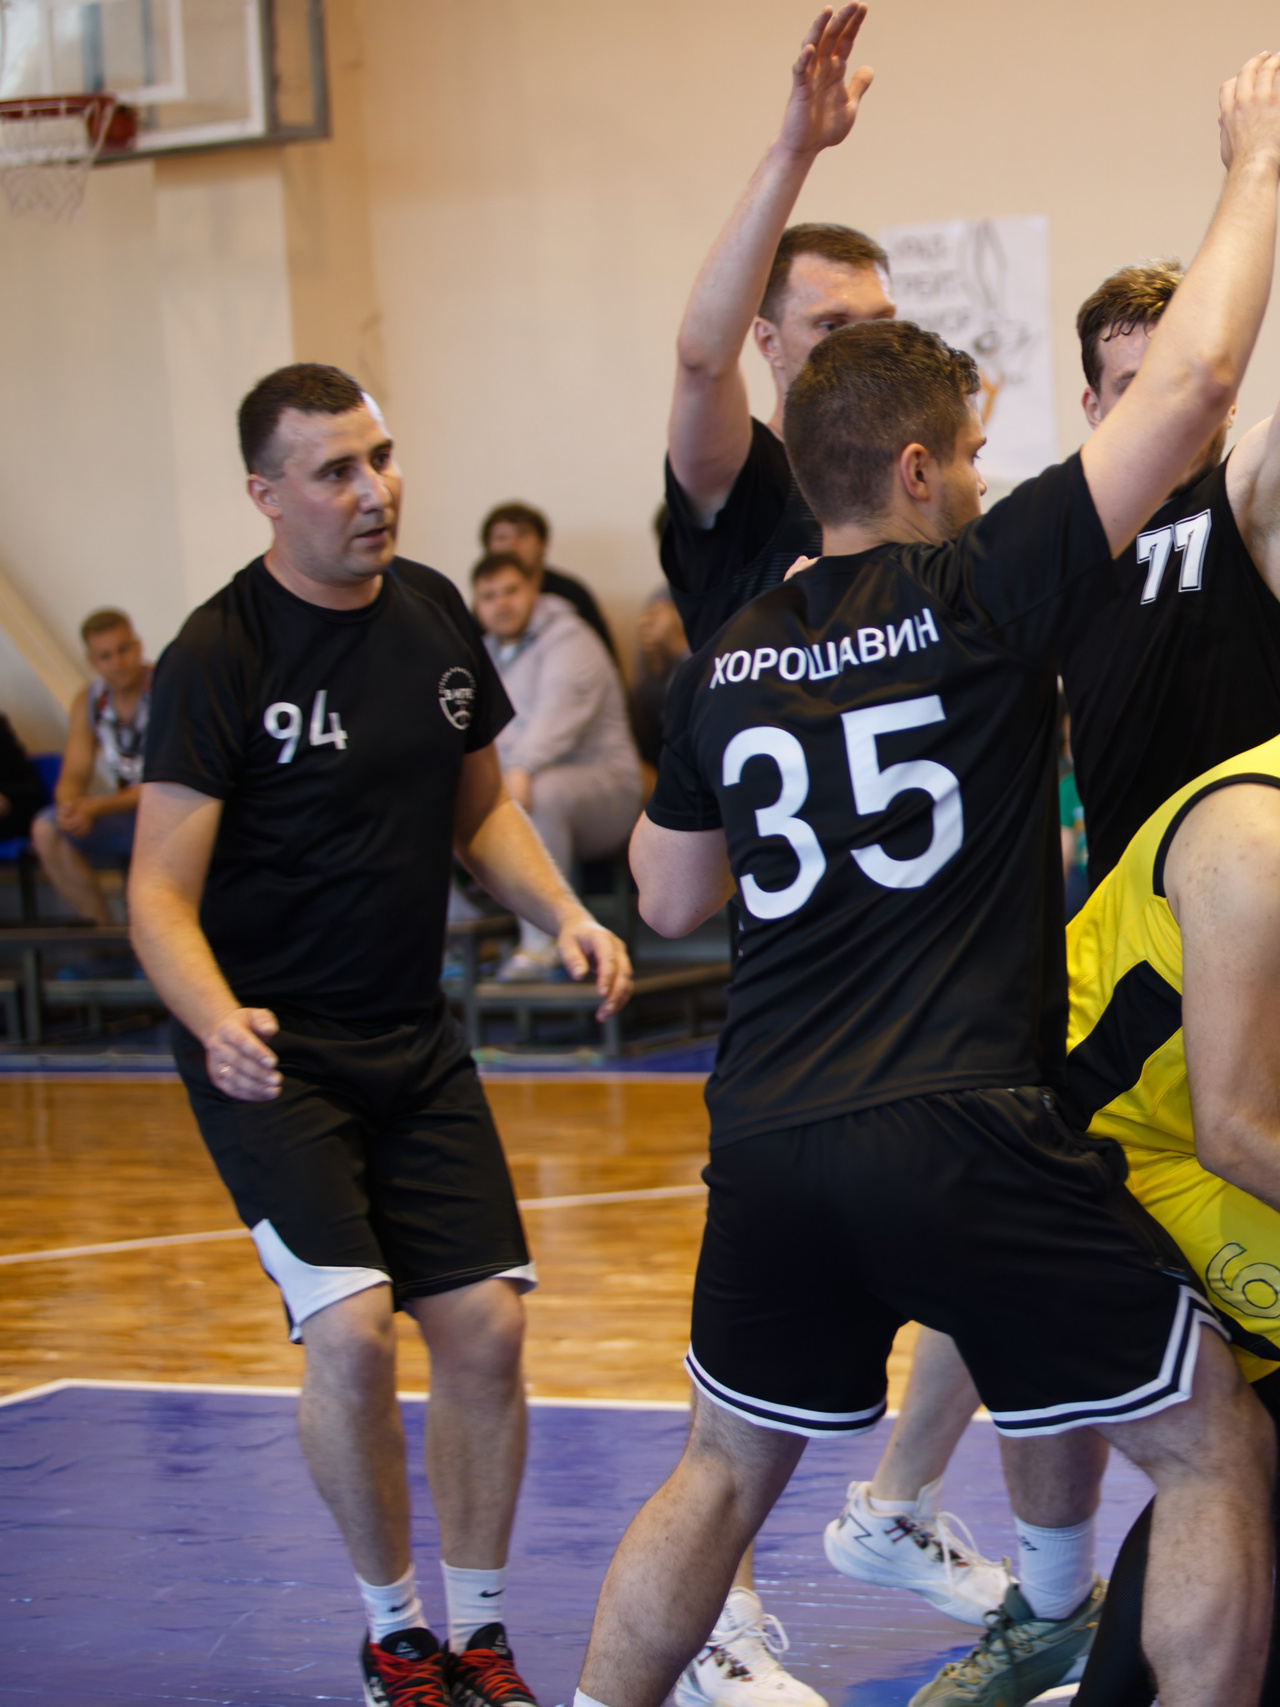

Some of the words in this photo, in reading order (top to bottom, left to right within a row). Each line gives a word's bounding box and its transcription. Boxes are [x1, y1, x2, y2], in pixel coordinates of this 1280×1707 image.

[1136, 508, 1212, 605] 77
[709, 608, 940, 690] ХОРОШАВИН
[264, 690, 348, 764] 94
[722, 694, 964, 920] 35
